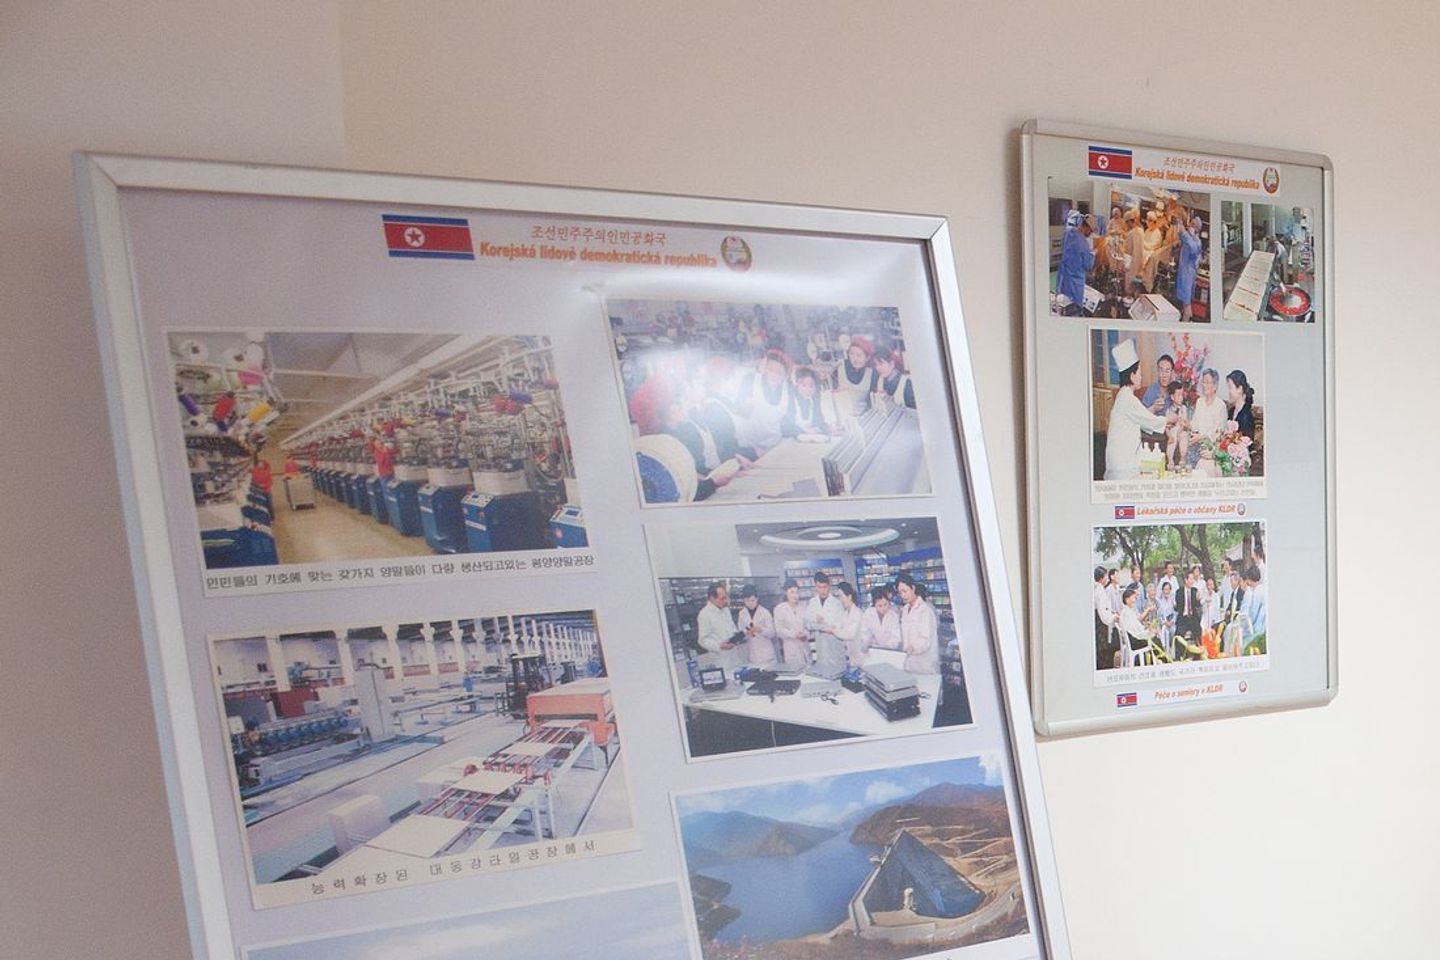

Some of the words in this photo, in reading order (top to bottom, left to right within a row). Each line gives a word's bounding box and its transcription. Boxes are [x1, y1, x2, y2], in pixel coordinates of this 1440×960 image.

[531, 225, 667, 247] 조선민주주의인민공화국
[479, 241, 536, 260] Korejská
[579, 246, 662, 265] demokratická
[663, 250, 718, 268] republika
[206, 574, 258, 591] 인민들의
